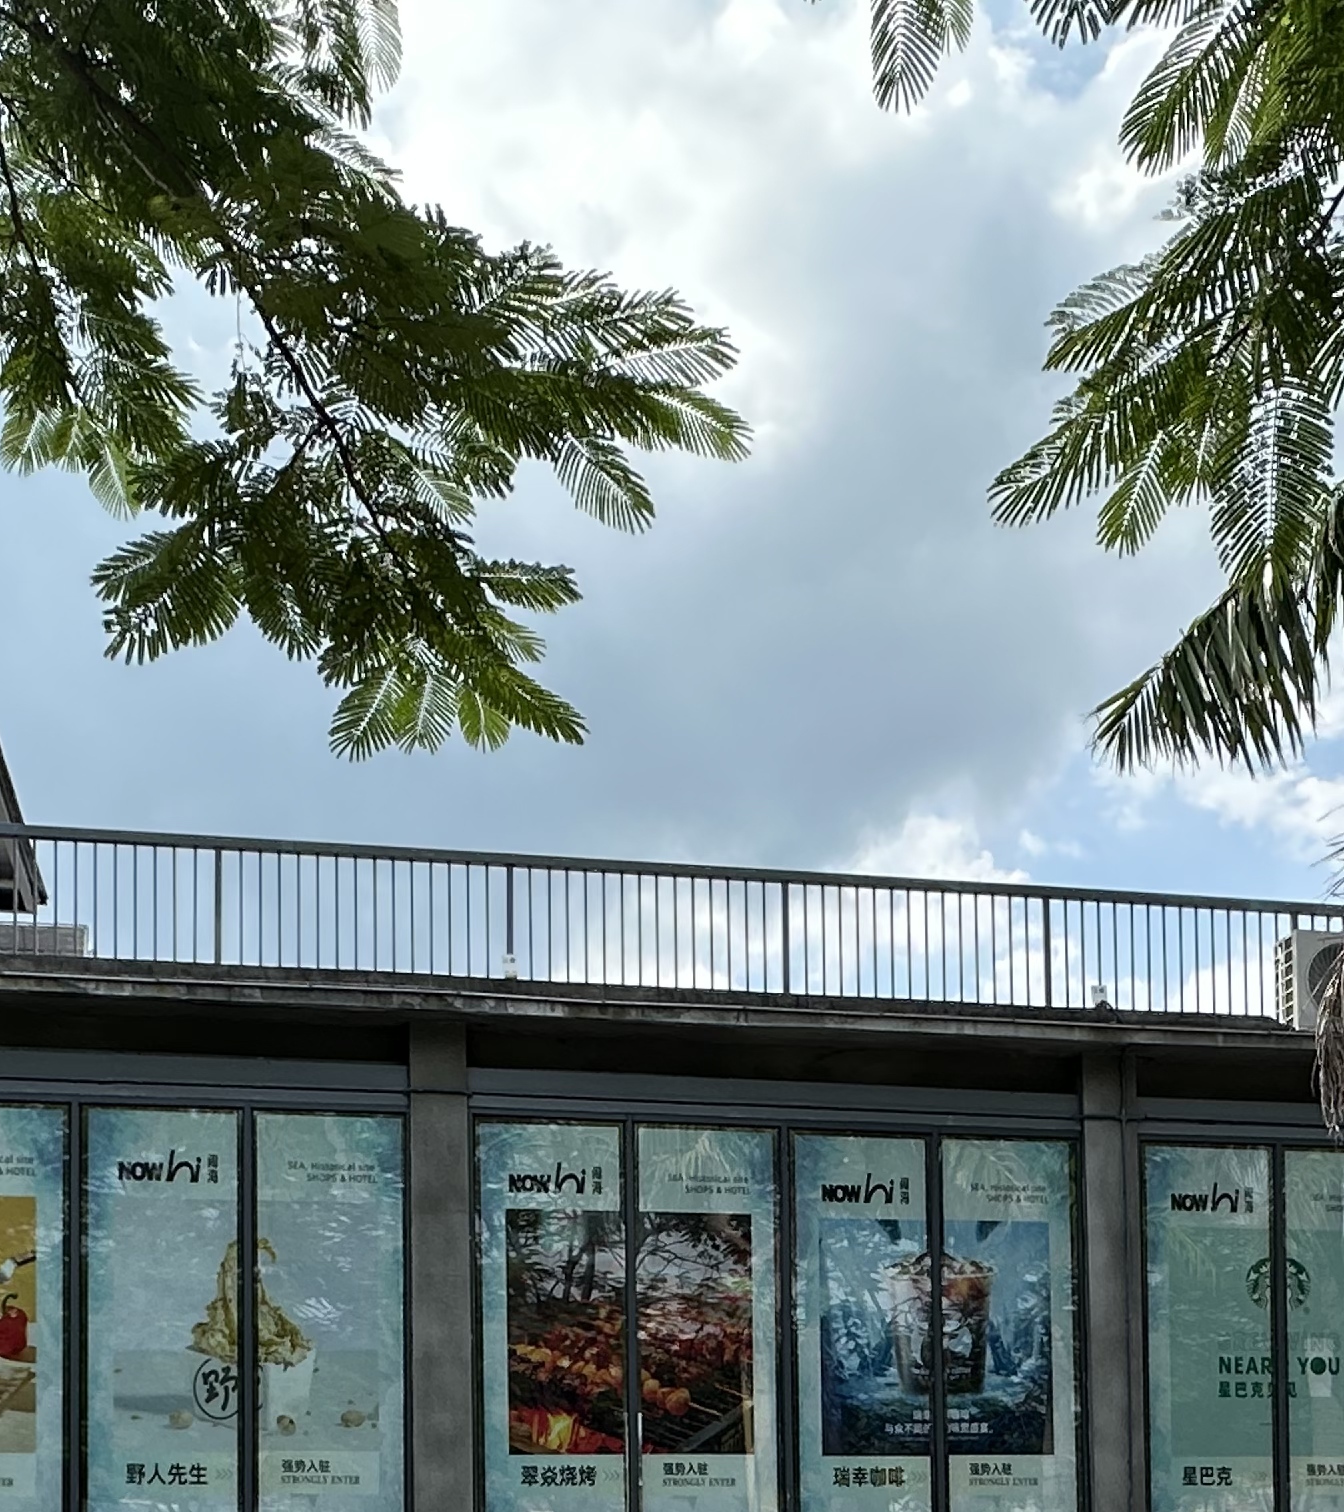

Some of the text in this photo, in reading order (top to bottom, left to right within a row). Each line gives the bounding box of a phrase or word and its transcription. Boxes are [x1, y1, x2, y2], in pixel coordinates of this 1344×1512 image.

[117, 1161, 163, 1182] NOW
[1170, 1193, 1209, 1212] NOW
[1296, 1356, 1340, 1376] YOU
[125, 1462, 208, 1486] 野人先生
[1182, 1466, 1233, 1487] 星巴克
